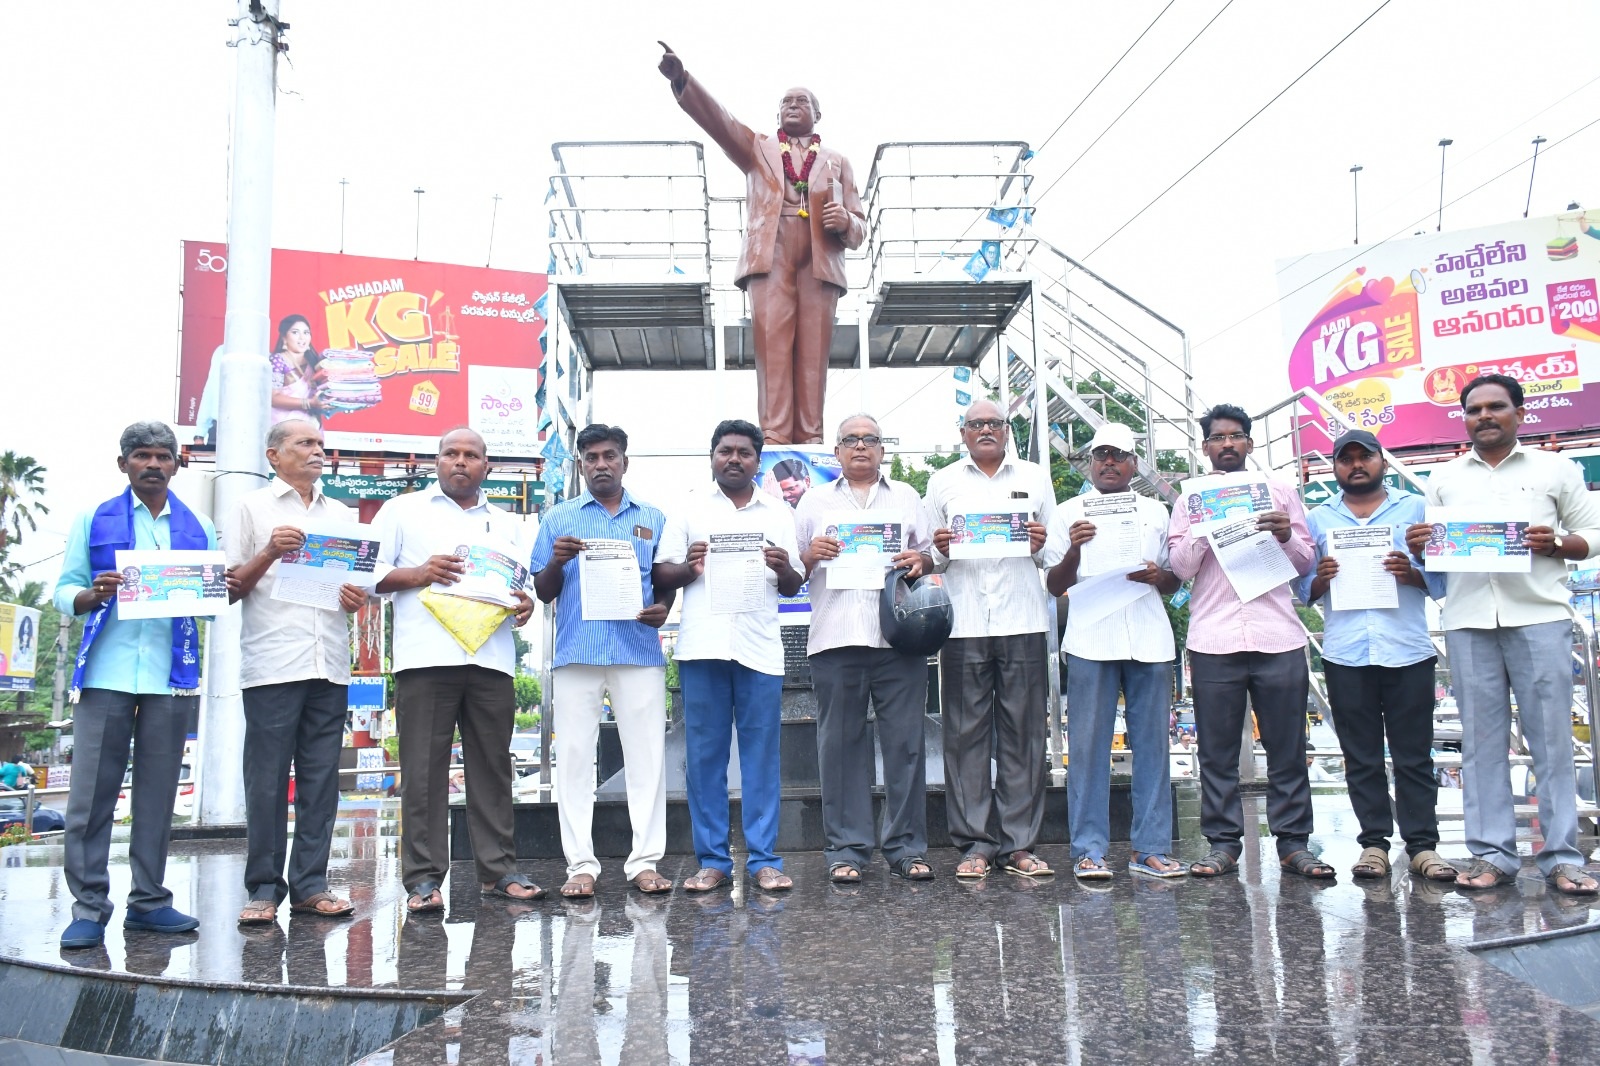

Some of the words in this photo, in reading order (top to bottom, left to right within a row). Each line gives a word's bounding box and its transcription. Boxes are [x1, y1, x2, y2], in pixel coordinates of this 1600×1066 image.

[197, 249, 228, 272] 50
[1435, 240, 1526, 278] హద్దేలేని
[328, 278, 404, 303] AASHADAM
[1441, 278, 1528, 305] అతివల
[325, 291, 433, 352] KG
[1320, 316, 1351, 338] AADI
[1433, 304, 1544, 337] ఆనందం
[1384, 312, 1415, 363] SALE
[374, 342, 460, 377] SALE
[1312, 321, 1380, 385] KG
[481, 394, 523, 417] స్వాతి
[1361, 405, 1395, 426] సేల్
